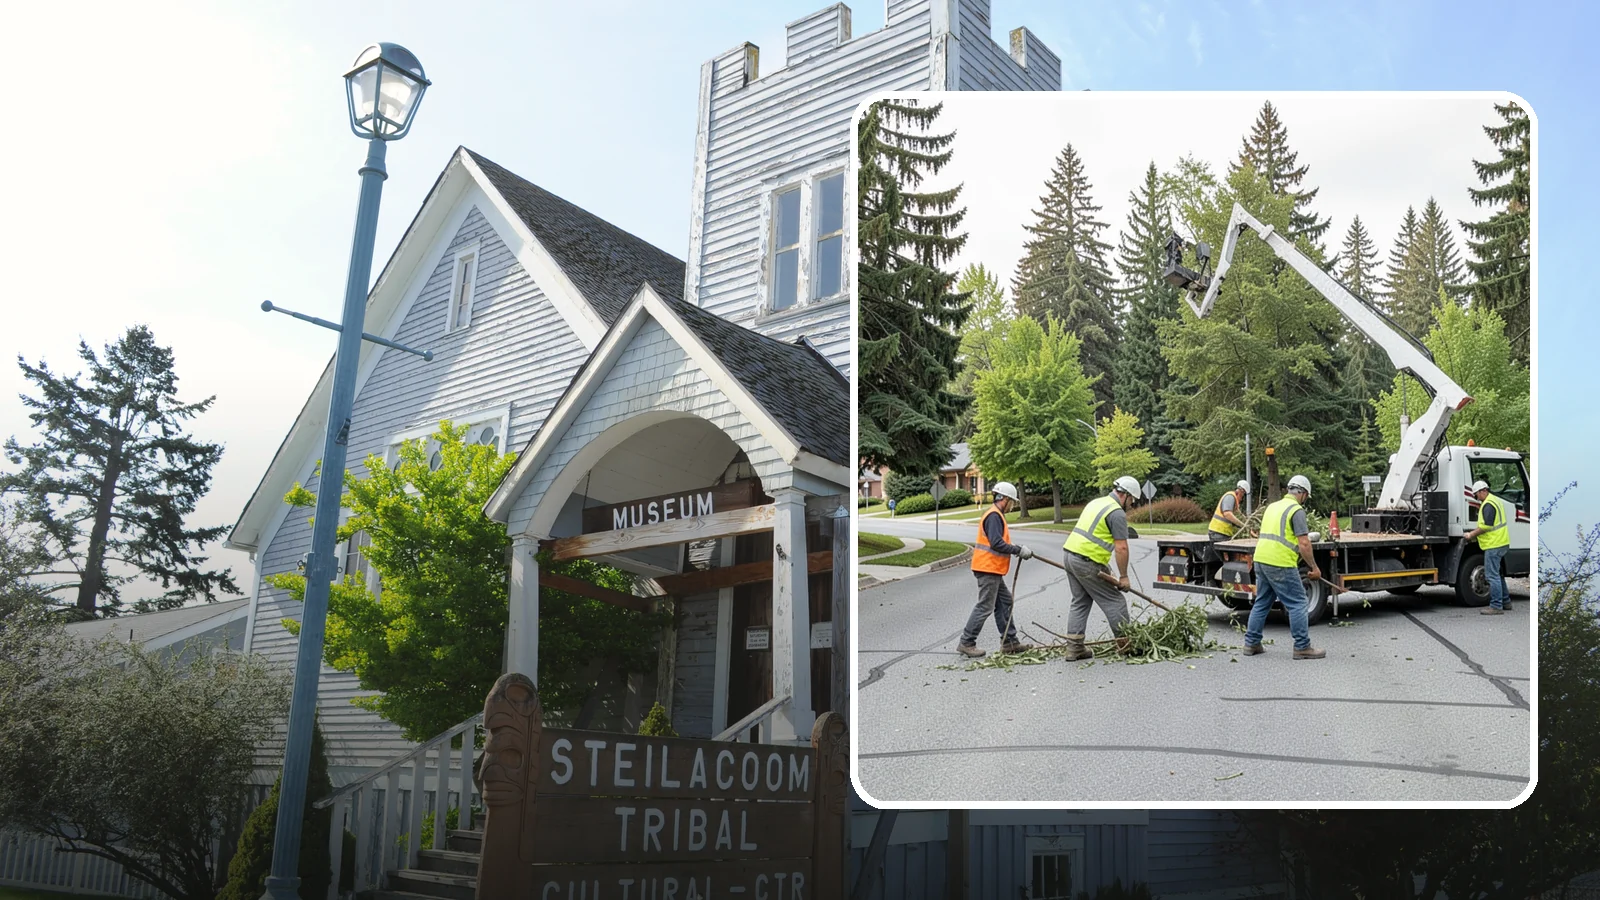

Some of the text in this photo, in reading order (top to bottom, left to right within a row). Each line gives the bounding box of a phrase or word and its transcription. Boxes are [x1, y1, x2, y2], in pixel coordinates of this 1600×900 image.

[613, 491, 714, 530] MUSEUM
[550, 738, 809, 792] STEILACOOM
[615, 806, 758, 851] TRIBAL
